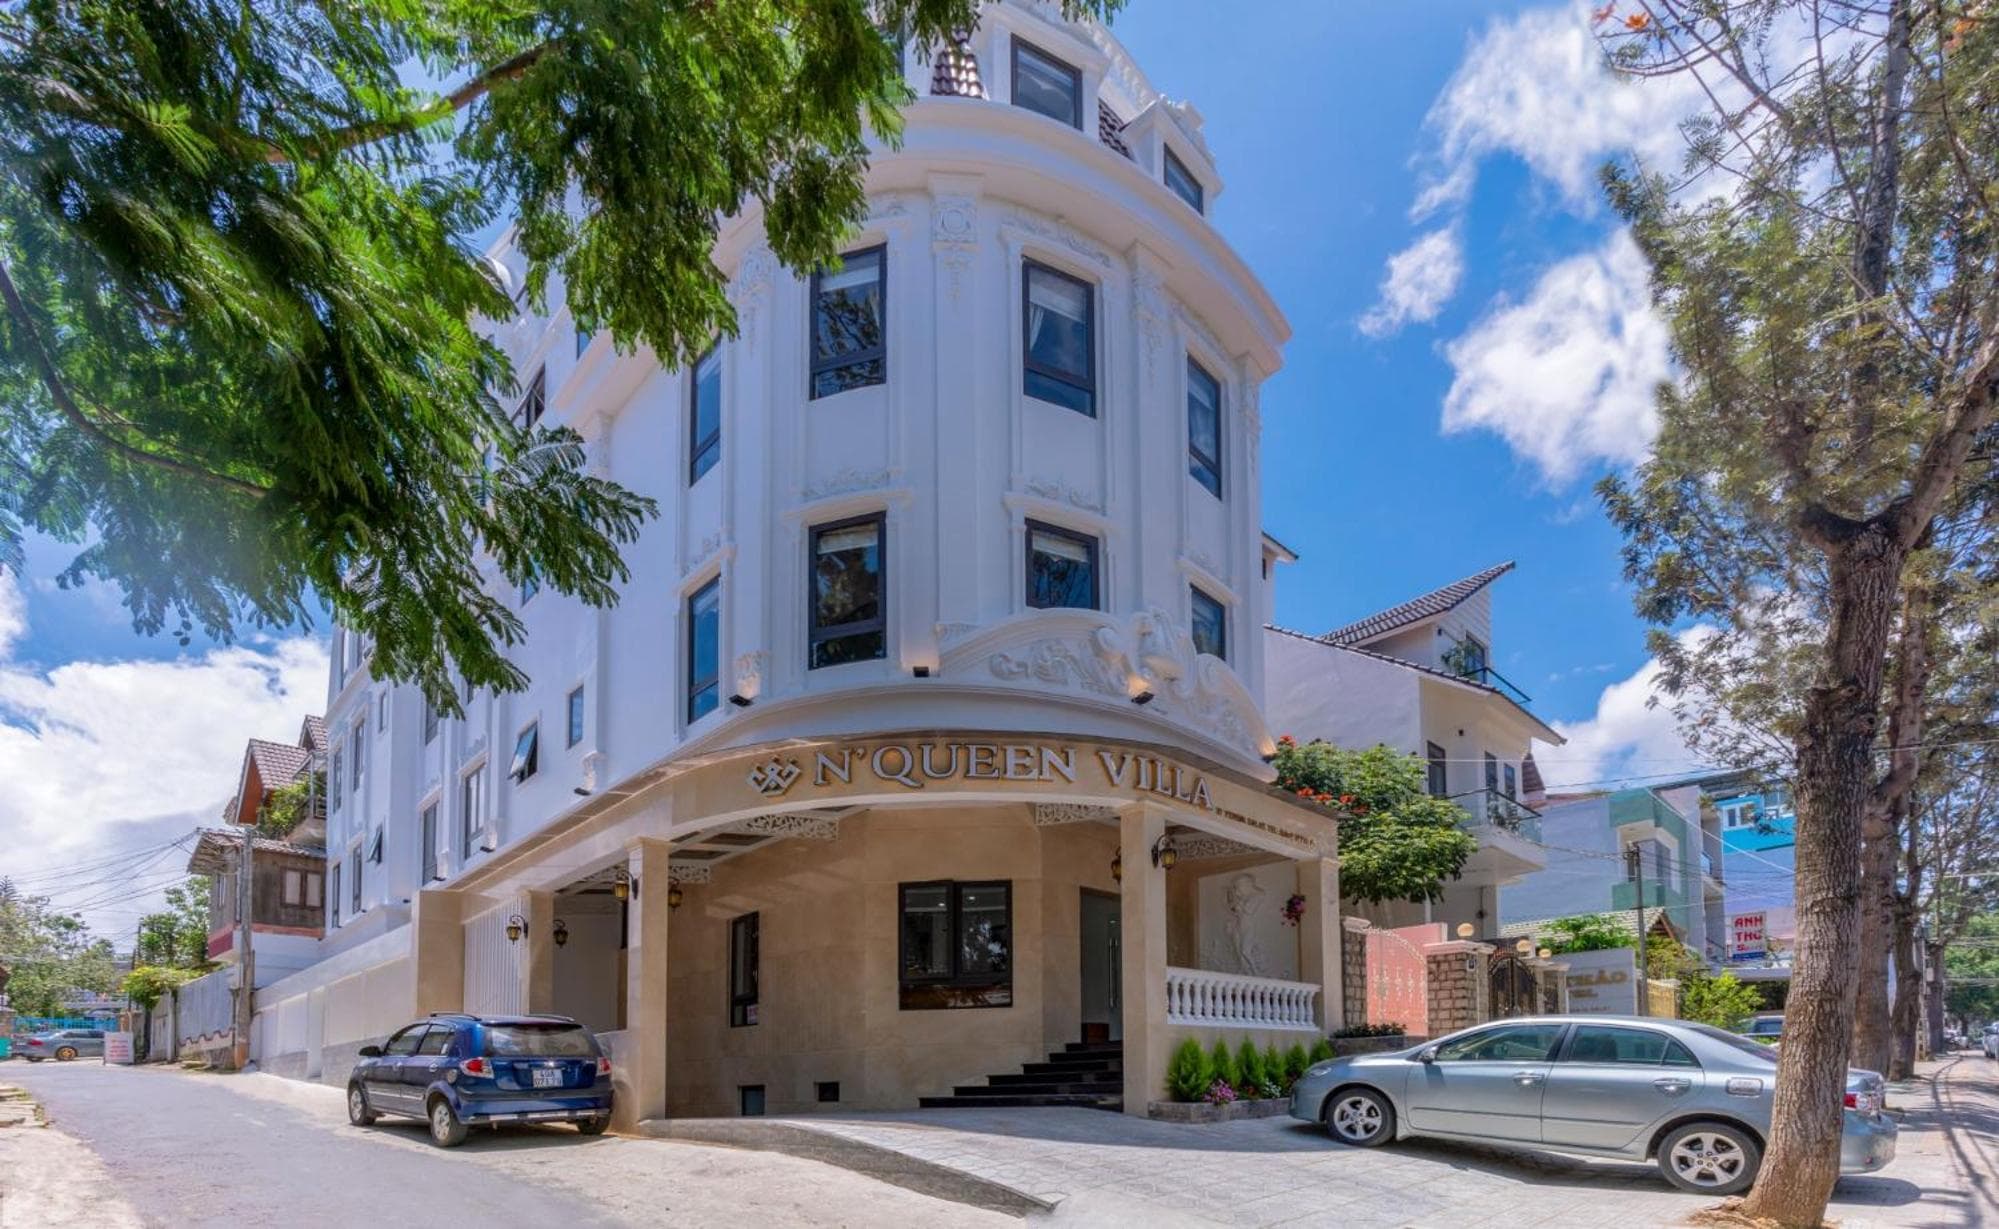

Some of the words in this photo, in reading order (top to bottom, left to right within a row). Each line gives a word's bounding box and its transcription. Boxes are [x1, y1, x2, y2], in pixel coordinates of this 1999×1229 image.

[813, 743, 1077, 788] N'QUEEN
[1096, 750, 1213, 811] VILLA
[1734, 915, 1763, 928] ANH
